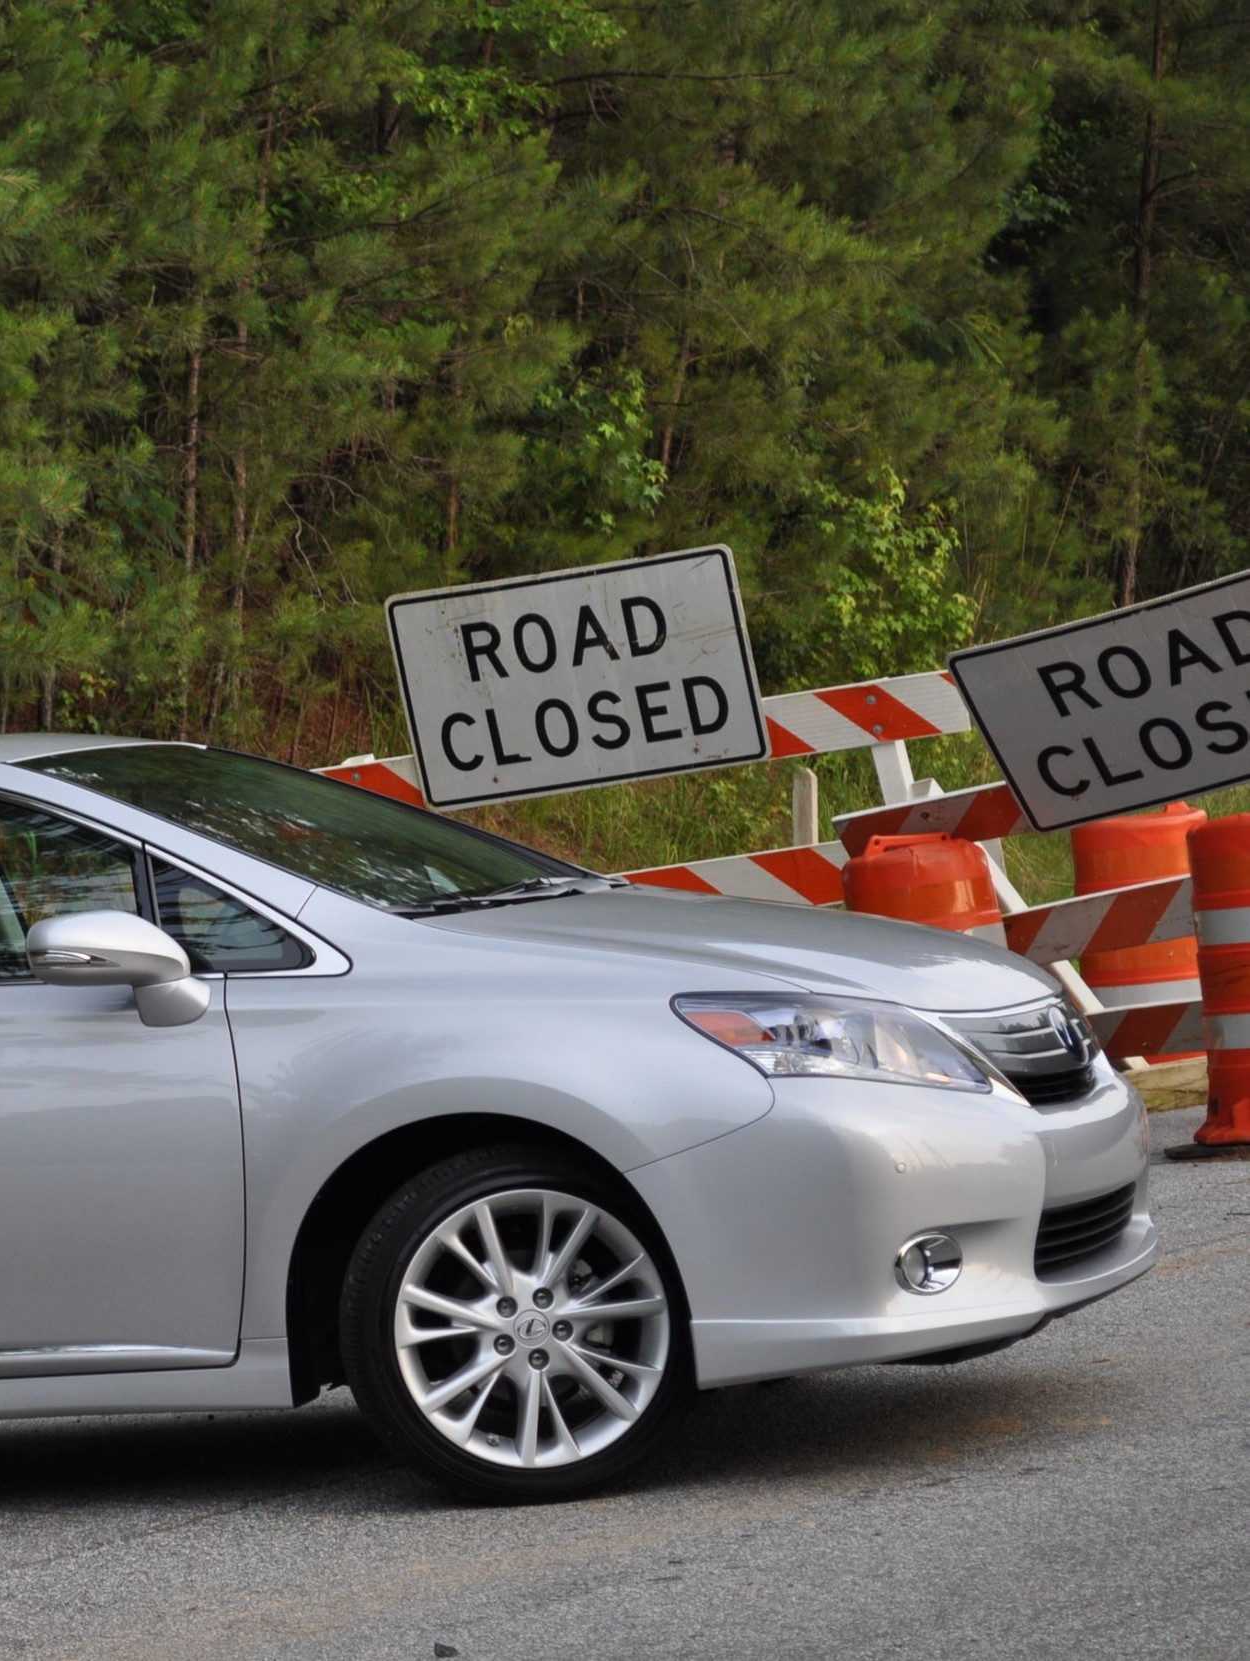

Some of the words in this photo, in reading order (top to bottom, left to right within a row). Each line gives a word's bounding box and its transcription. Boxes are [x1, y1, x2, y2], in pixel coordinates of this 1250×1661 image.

[460, 595, 668, 683] ROAD
[1036, 610, 1250, 718] ROAD
[440, 675, 730, 772] CLOSED
[1036, 690, 1250, 798] CLOS
